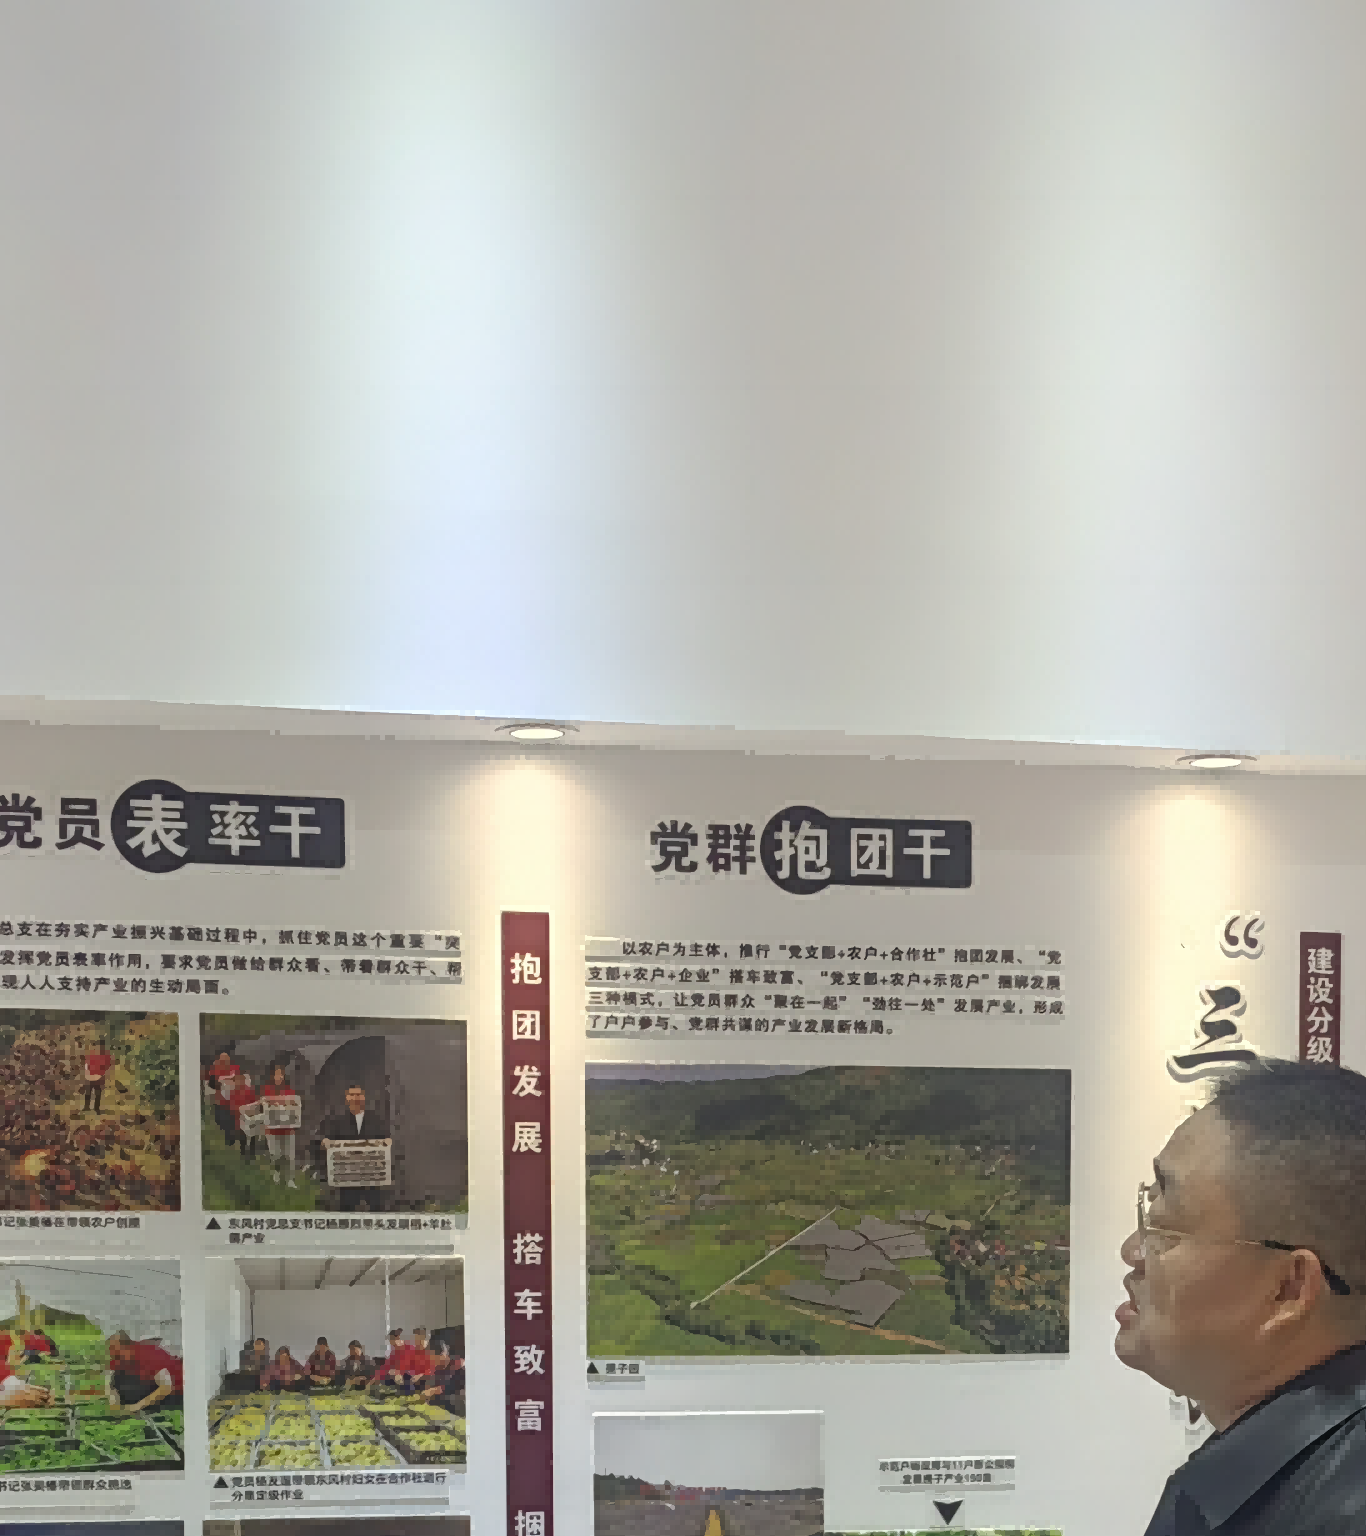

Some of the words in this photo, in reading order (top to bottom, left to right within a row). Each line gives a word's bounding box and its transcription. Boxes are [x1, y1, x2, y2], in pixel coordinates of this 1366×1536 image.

[649, 820, 952, 881] 党群抱团干
[510, 952, 544, 1154] 抱团发展
[1306, 947, 1335, 1064] 建设分级
[512, 1231, 547, 1432] 搭车致富
